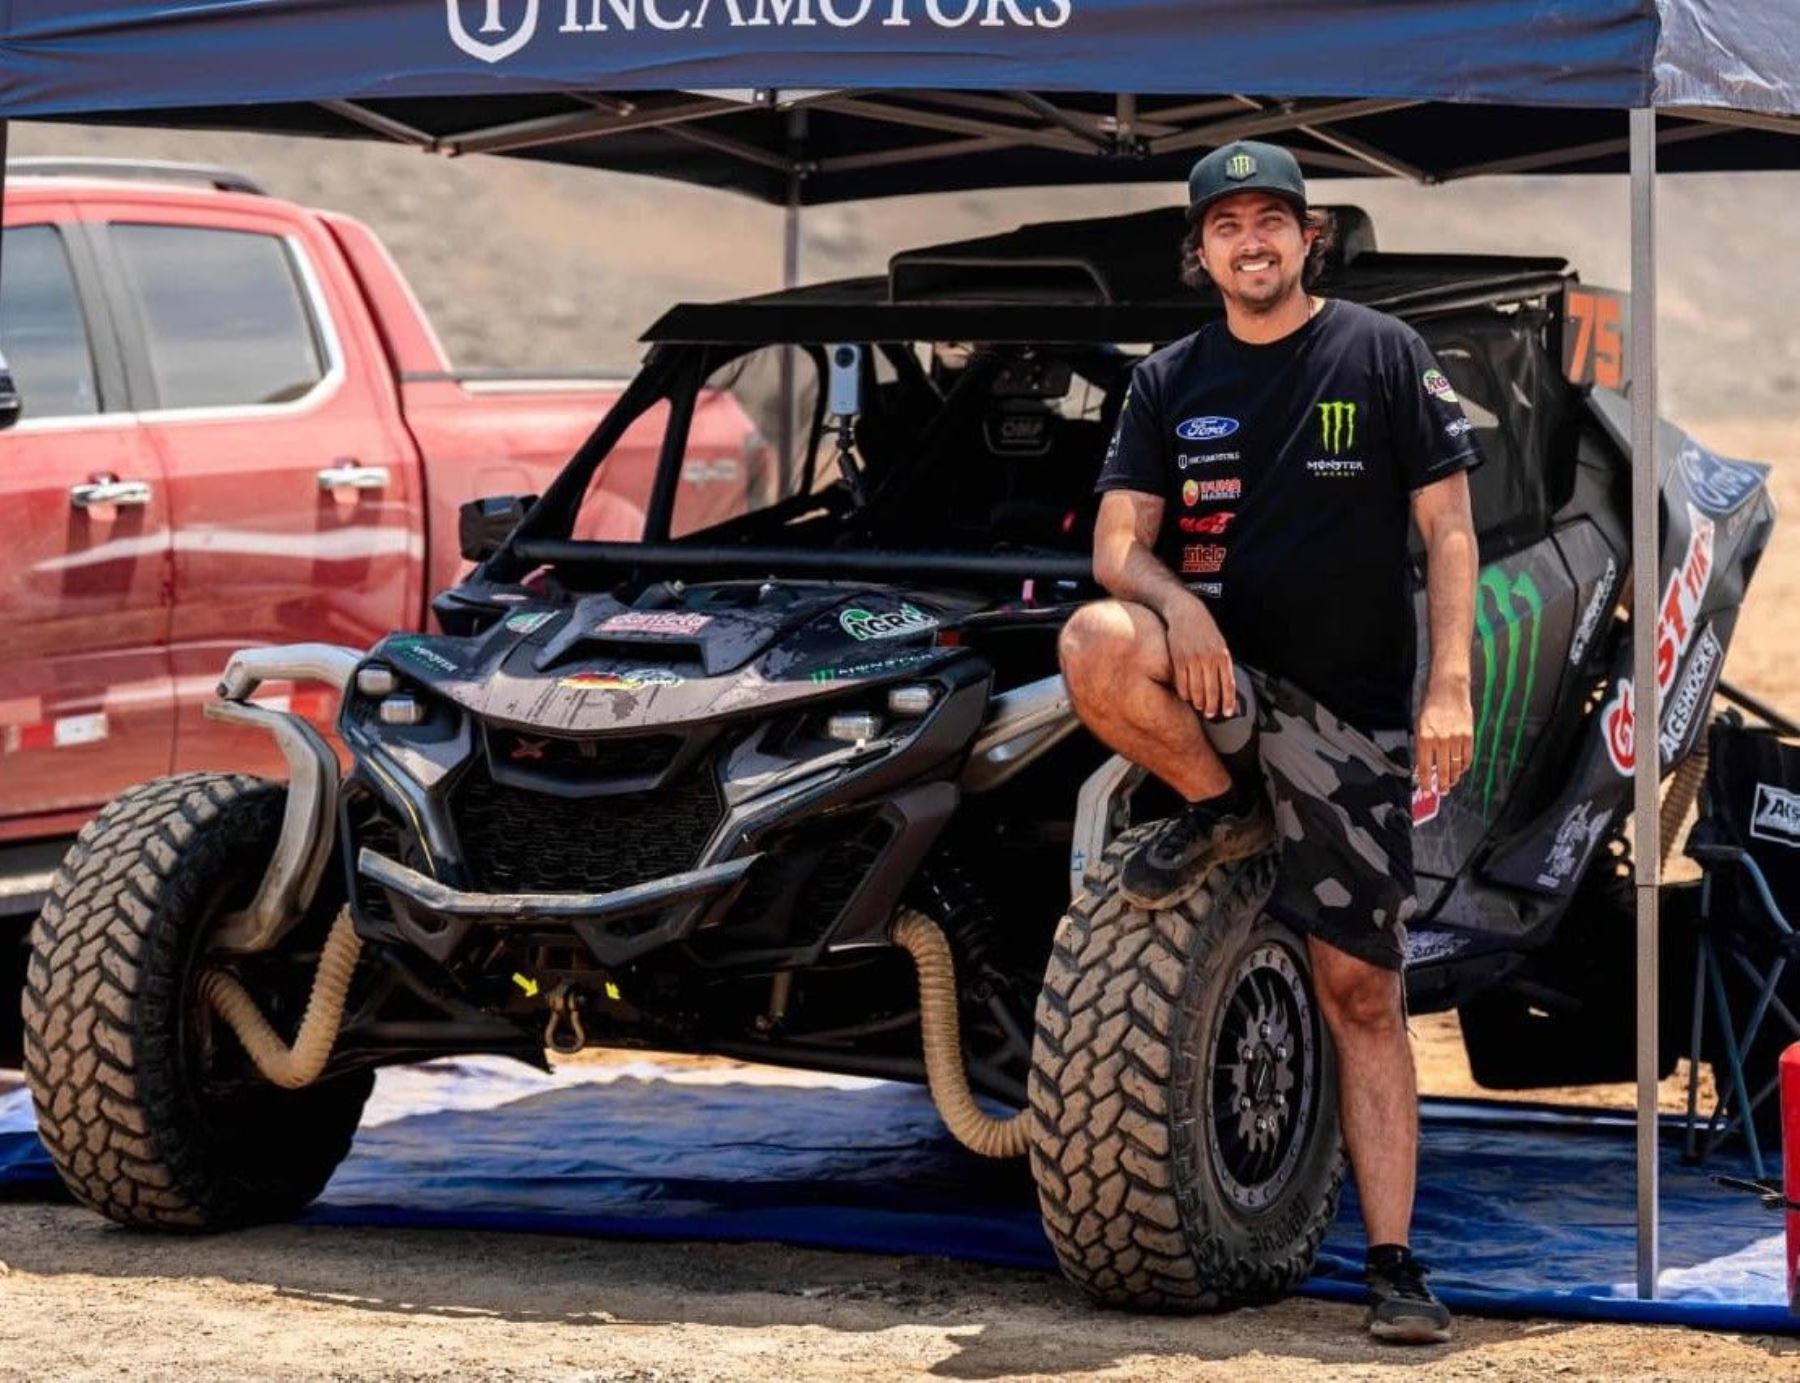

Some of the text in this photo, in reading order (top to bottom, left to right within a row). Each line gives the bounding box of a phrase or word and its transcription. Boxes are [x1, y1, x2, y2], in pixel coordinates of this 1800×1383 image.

[1567, 291, 1622, 388] 75
[1186, 419, 1229, 437] Ford
[1306, 459, 1364, 471] MONSTER
[1659, 629, 1717, 766] AGSHOCKS
